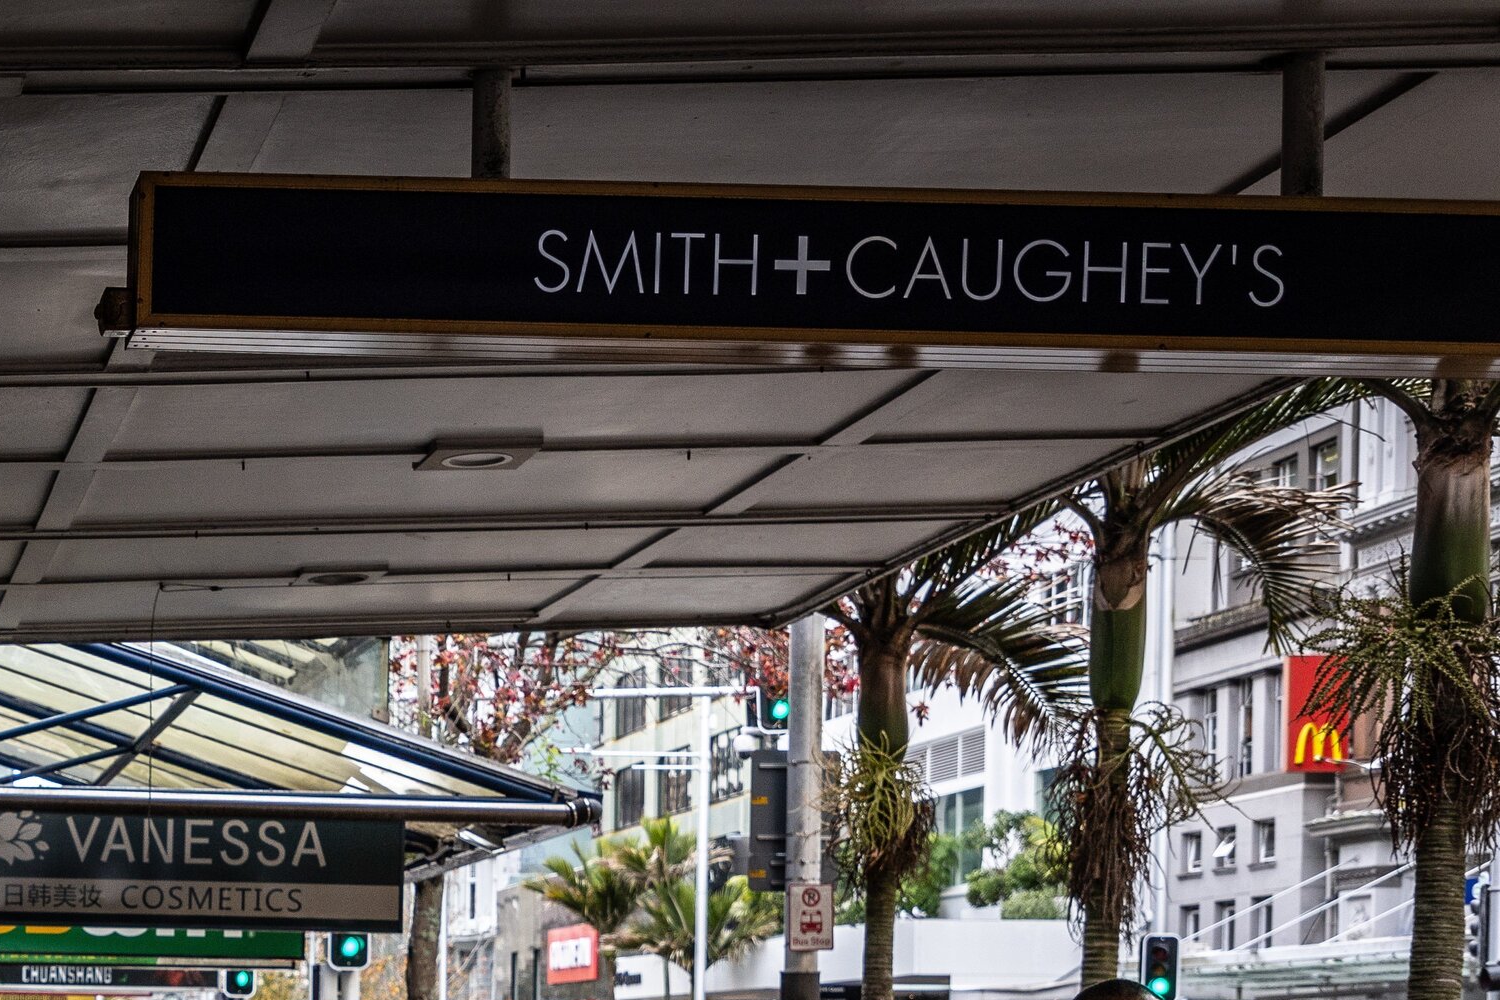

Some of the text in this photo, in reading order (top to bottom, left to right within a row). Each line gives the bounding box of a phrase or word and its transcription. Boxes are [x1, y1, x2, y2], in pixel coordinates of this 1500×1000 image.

[64, 814, 328, 868] VANESSA
[4, 883, 104, 910] 日韩美妆
[120, 884, 304, 914] COSMETICS
[792, 936, 831, 947] Bus Stop
[21, 965, 113, 984] CHUANSHANG
